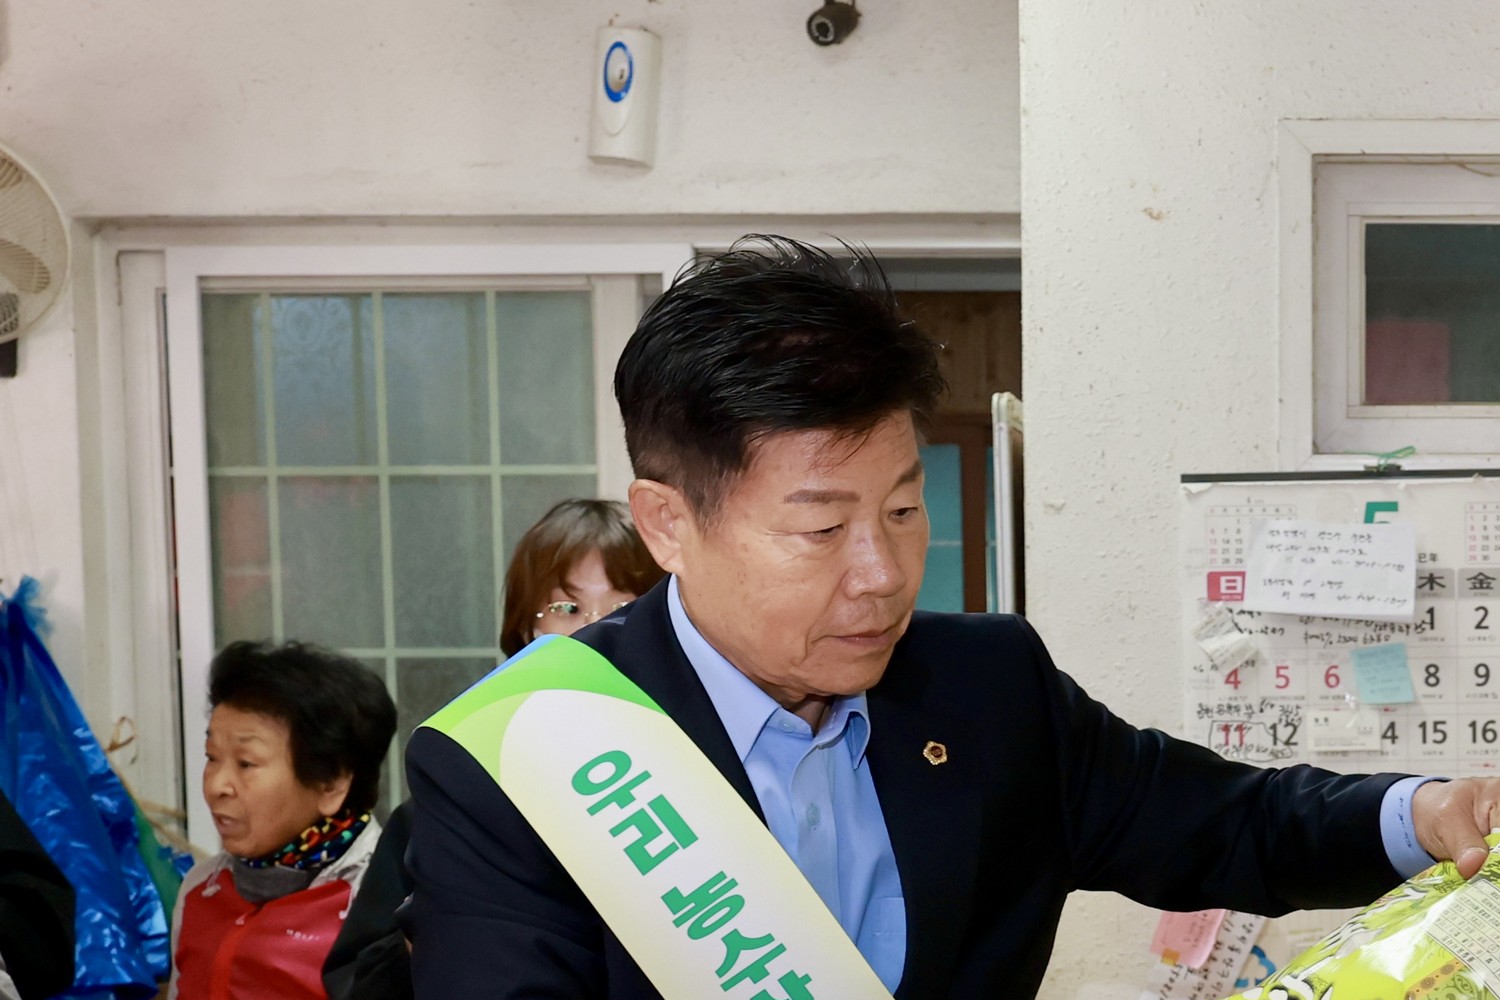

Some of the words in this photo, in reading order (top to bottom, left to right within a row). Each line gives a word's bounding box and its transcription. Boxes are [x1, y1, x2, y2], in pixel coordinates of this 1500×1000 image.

[1417, 572, 1446, 591] 木
[1466, 572, 1496, 590] 金
[1425, 606, 1435, 630] 1
[1474, 606, 1489, 630] 2
[1224, 667, 1241, 690] 4
[1275, 665, 1290, 689] 5
[1324, 665, 1340, 688] 6
[1424, 663, 1440, 687] 8
[1474, 663, 1490, 687] 9
[1269, 723, 1298, 746] 12
[1418, 720, 1447, 744] 15
[1468, 720, 1498, 744] 16
[571, 749, 699, 876] 우리
